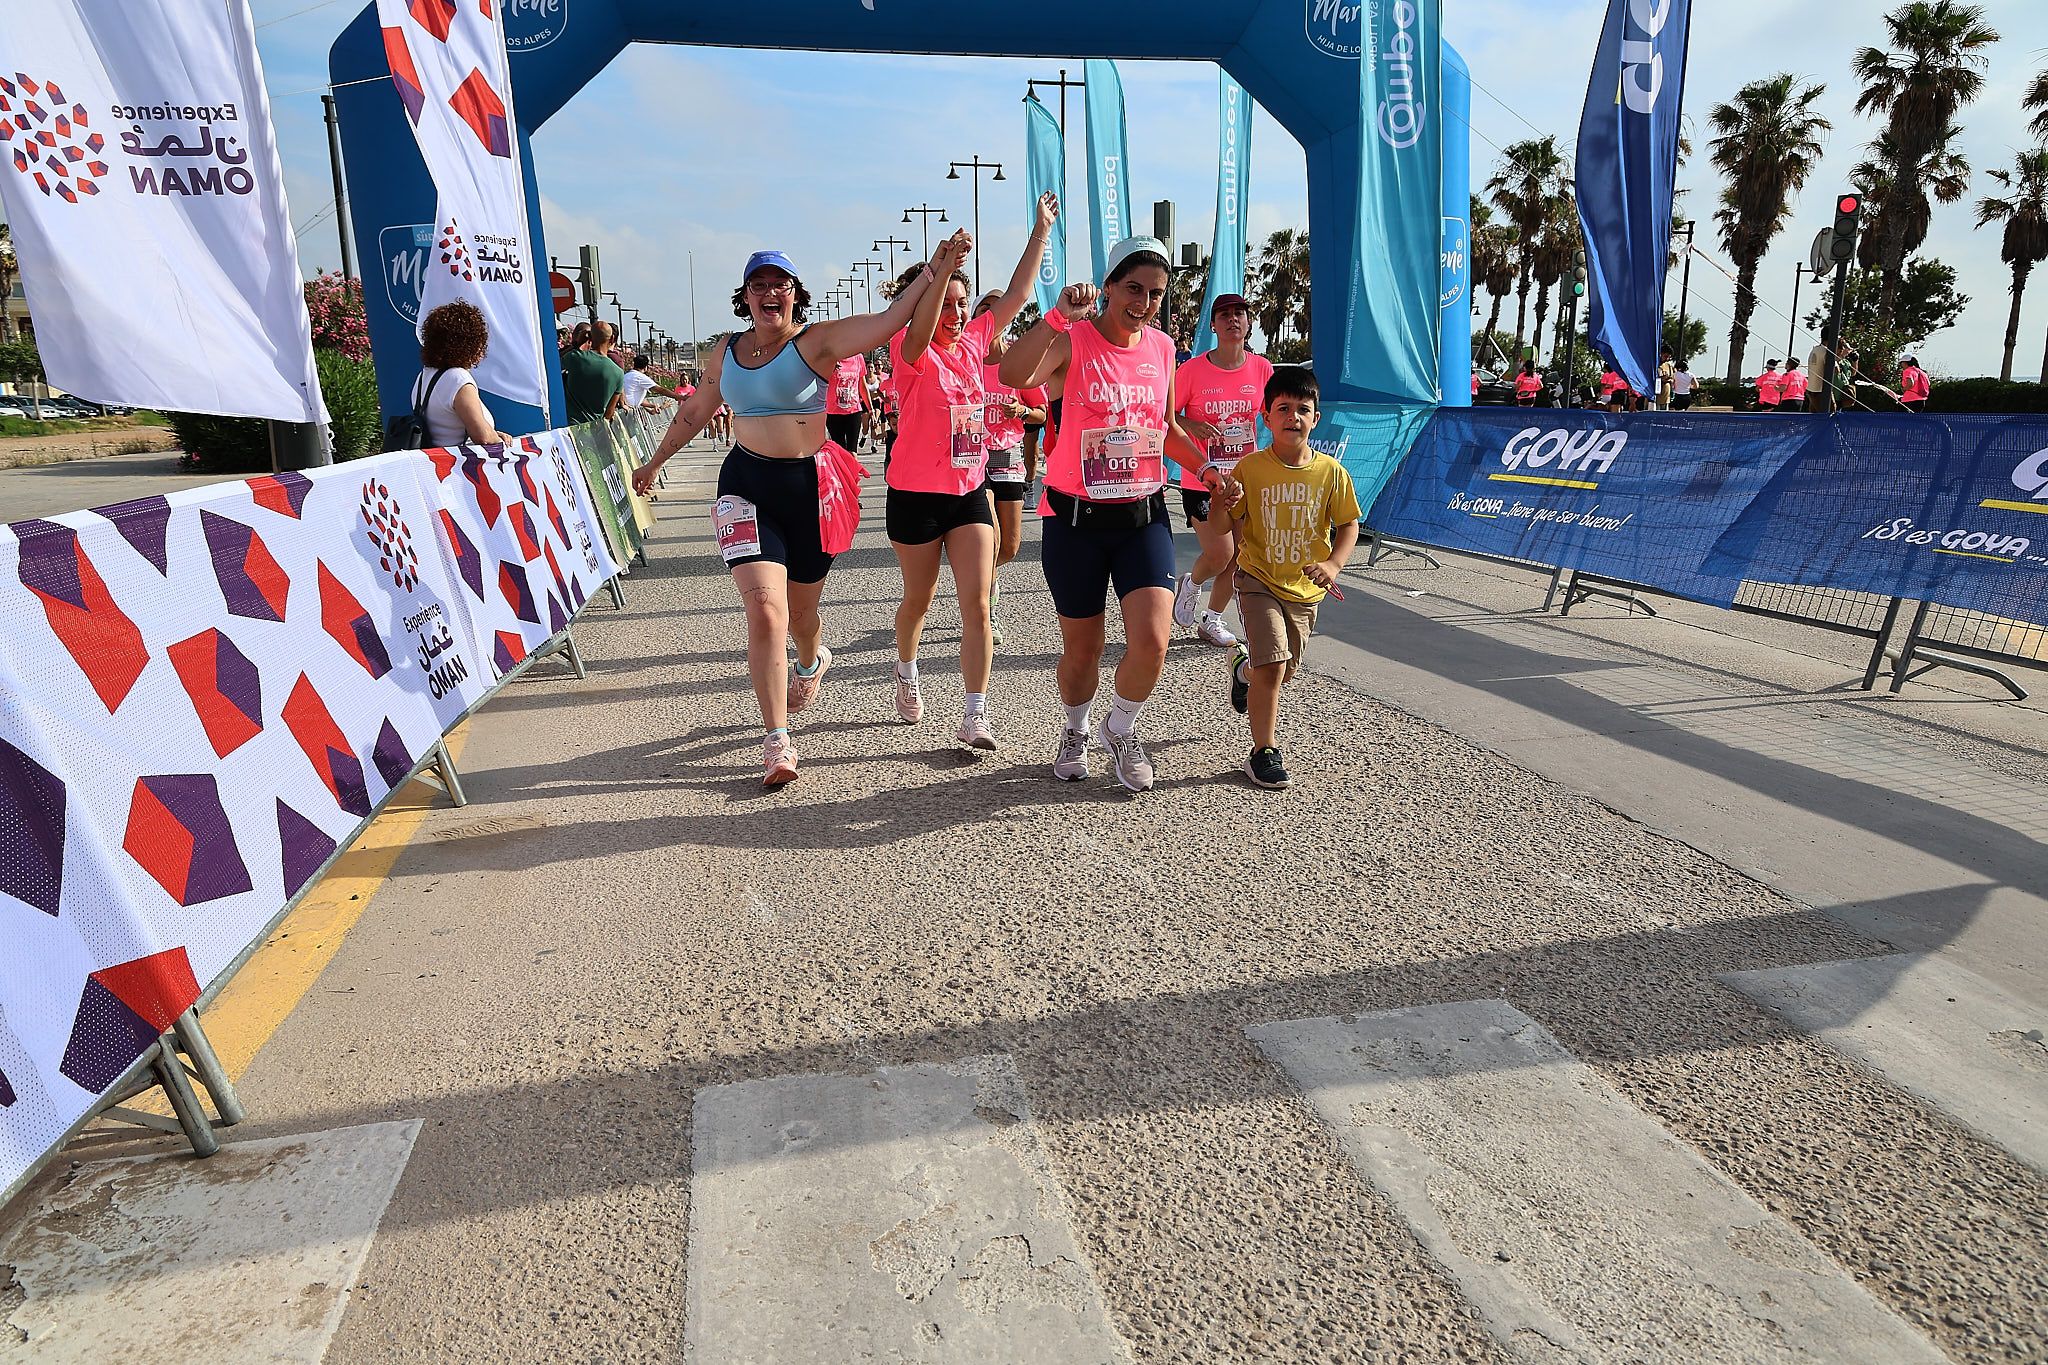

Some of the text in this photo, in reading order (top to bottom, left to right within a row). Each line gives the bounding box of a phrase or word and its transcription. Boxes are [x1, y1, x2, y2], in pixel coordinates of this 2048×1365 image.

[505, 28, 552, 46] OS ALPES
[1317, 34, 1361, 54] HIJA DE LO
[1440, 283, 1460, 302] ALPES
[1225, 445, 1243, 453] 016
[1500, 427, 1629, 473] GOYA
[1108, 457, 1139, 470] 016
[1260, 505, 1277, 530] IN
[1527, 508, 1557, 530] que
[1556, 510, 1580, 523] ser
[1578, 504, 1633, 531] bueno!
[1905, 529, 1941, 545] es
[402, 602, 442, 634] Experience
[428, 653, 468, 700] OMAN
